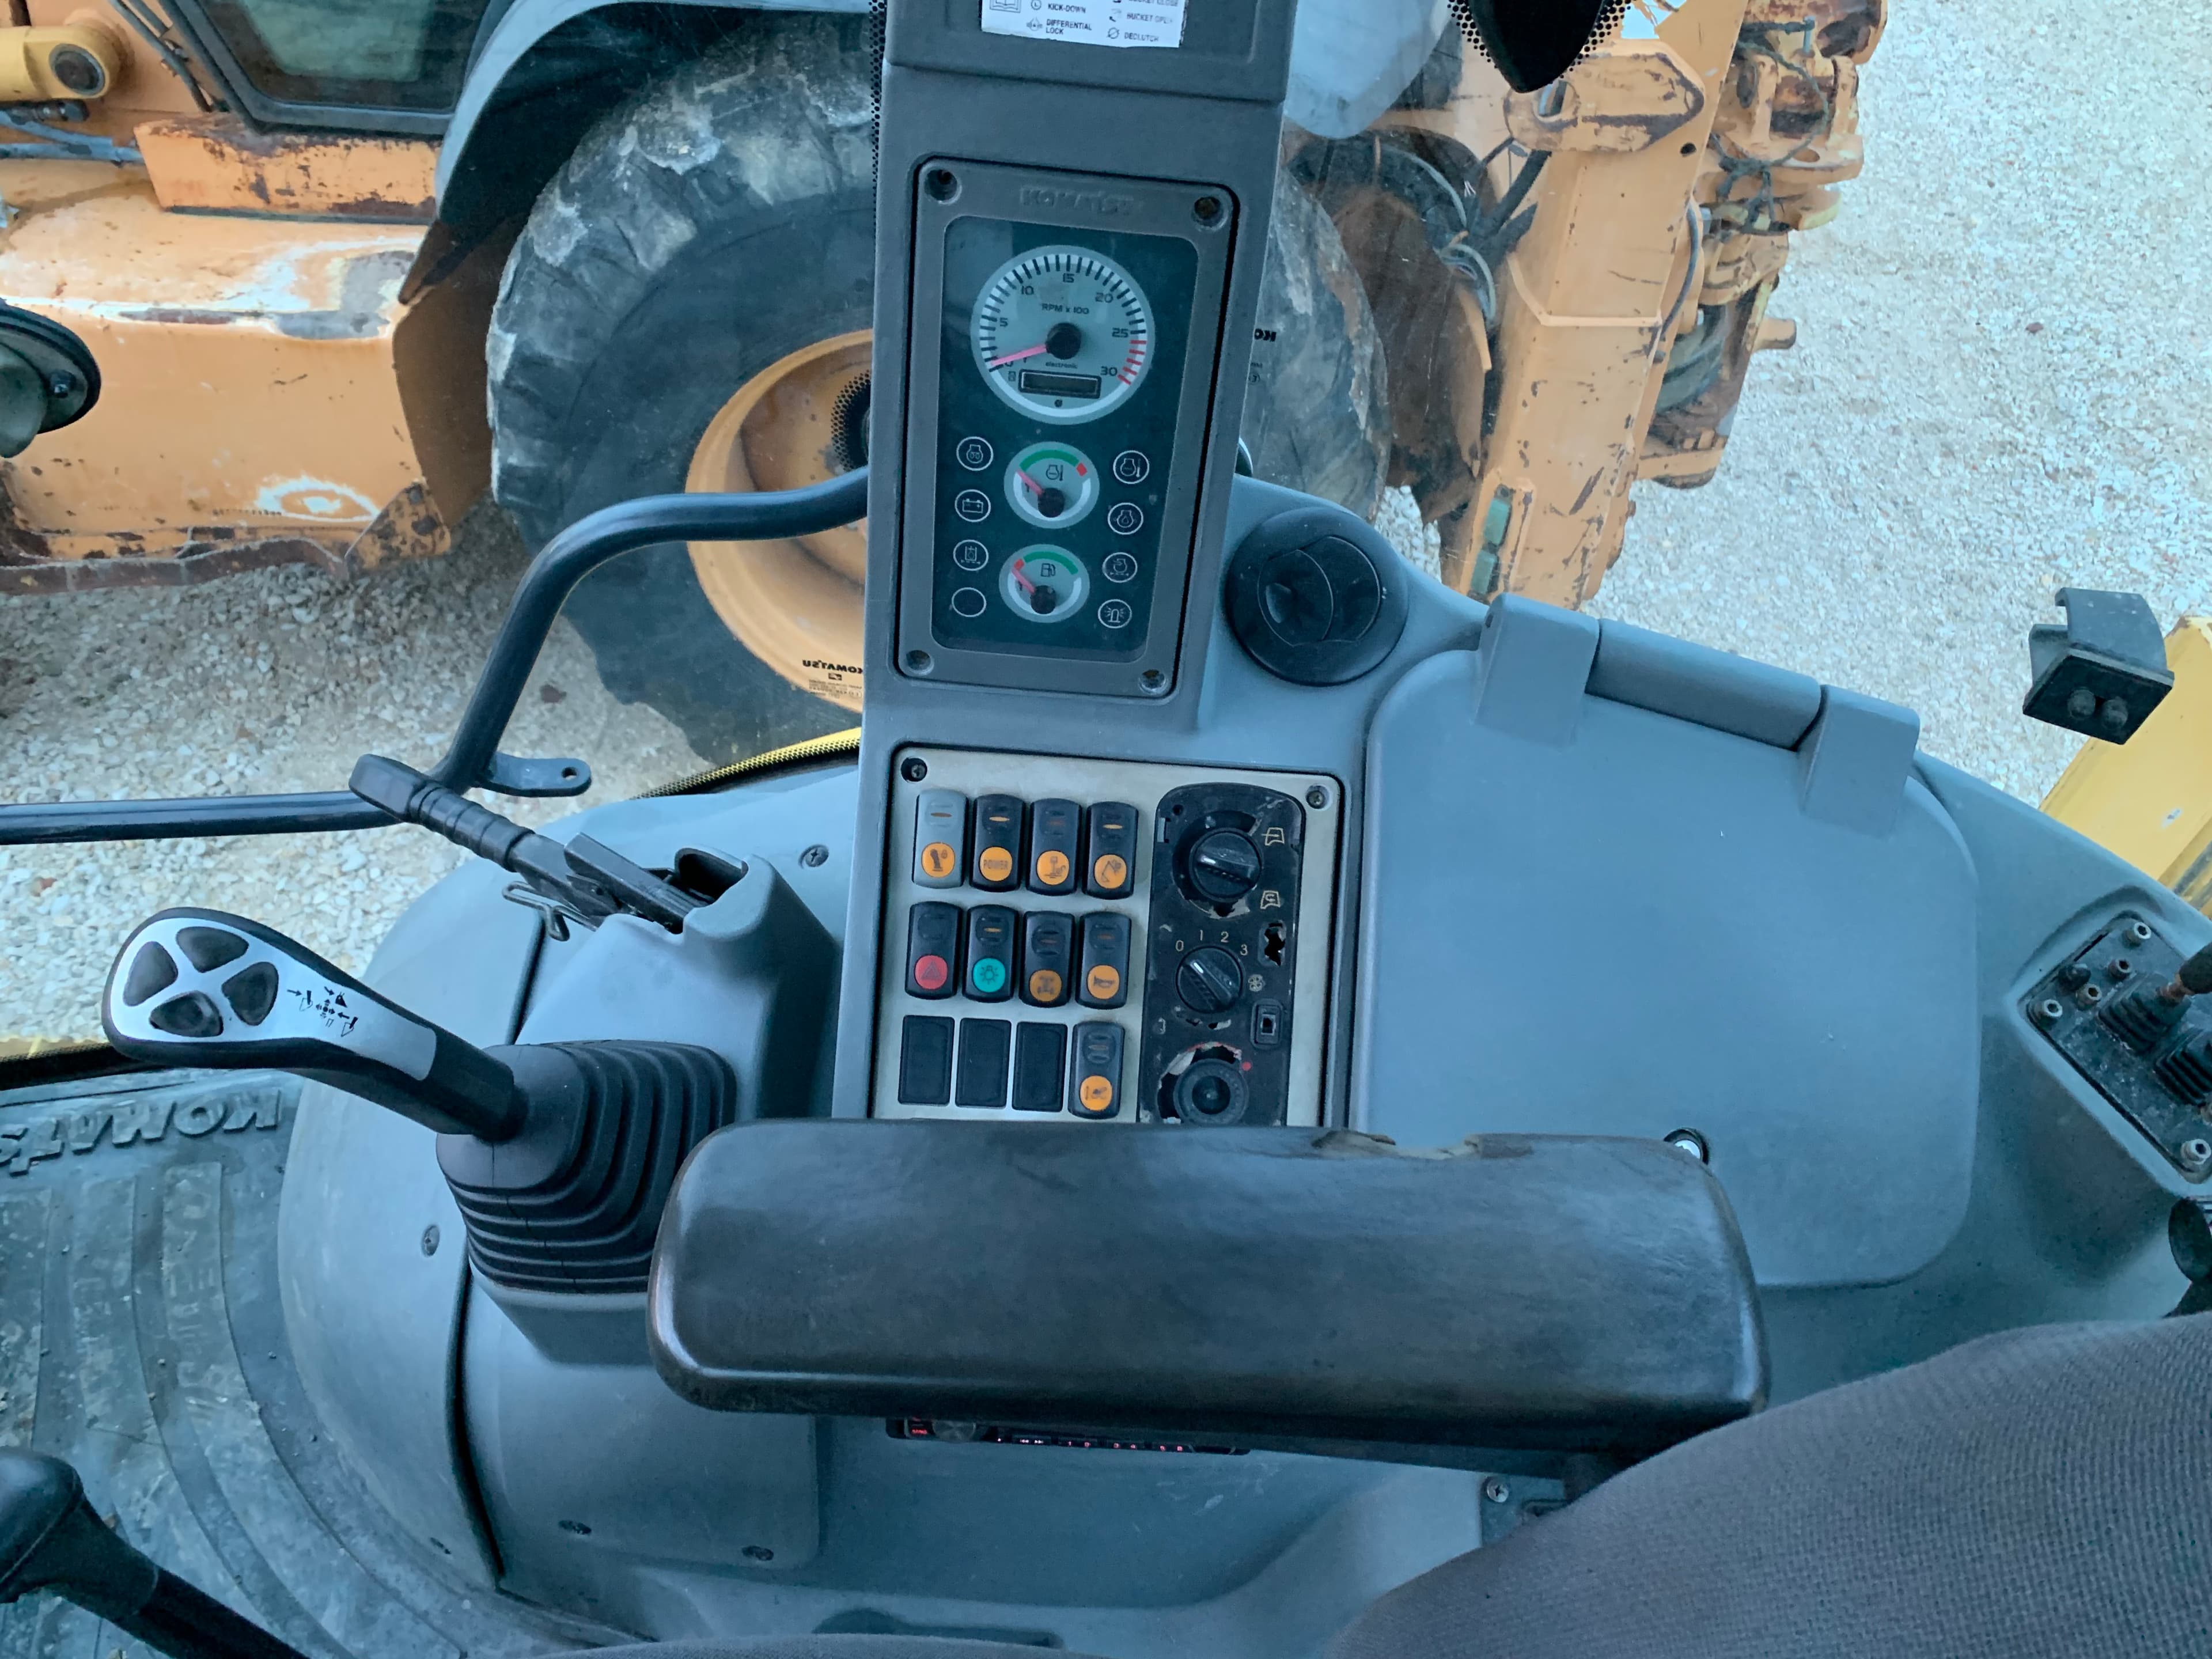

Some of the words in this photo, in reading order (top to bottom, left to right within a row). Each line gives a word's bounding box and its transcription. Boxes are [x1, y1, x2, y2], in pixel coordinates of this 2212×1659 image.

[1048, 3, 1086, 13] KICK-DOWN
[1127, 13, 1153, 22] BUCKET
[1046, 19, 1093, 31] DIFFERENTIAL
[1046, 27, 1065, 35] LOCK
[1124, 32, 1160, 42] DECLUTCH
[1063, 273, 1075, 283] 15
[1021, 285, 1035, 296] 10
[1095, 292, 1113, 303] 20
[1041, 303, 1063, 313] RPM
[1073, 306, 1090, 315] 100
[999, 318, 1009, 328] 5
[1112, 327, 1129, 338] 25
[1045, 361, 1078, 369] electronic
[1101, 366, 1118, 377] 30
[983, 859, 1009, 870] POWER
[1175, 940, 1184, 952] 0
[1199, 930, 1203, 941] 1
[1221, 931, 1229, 943] 2
[1240, 944, 1248, 956] 3
